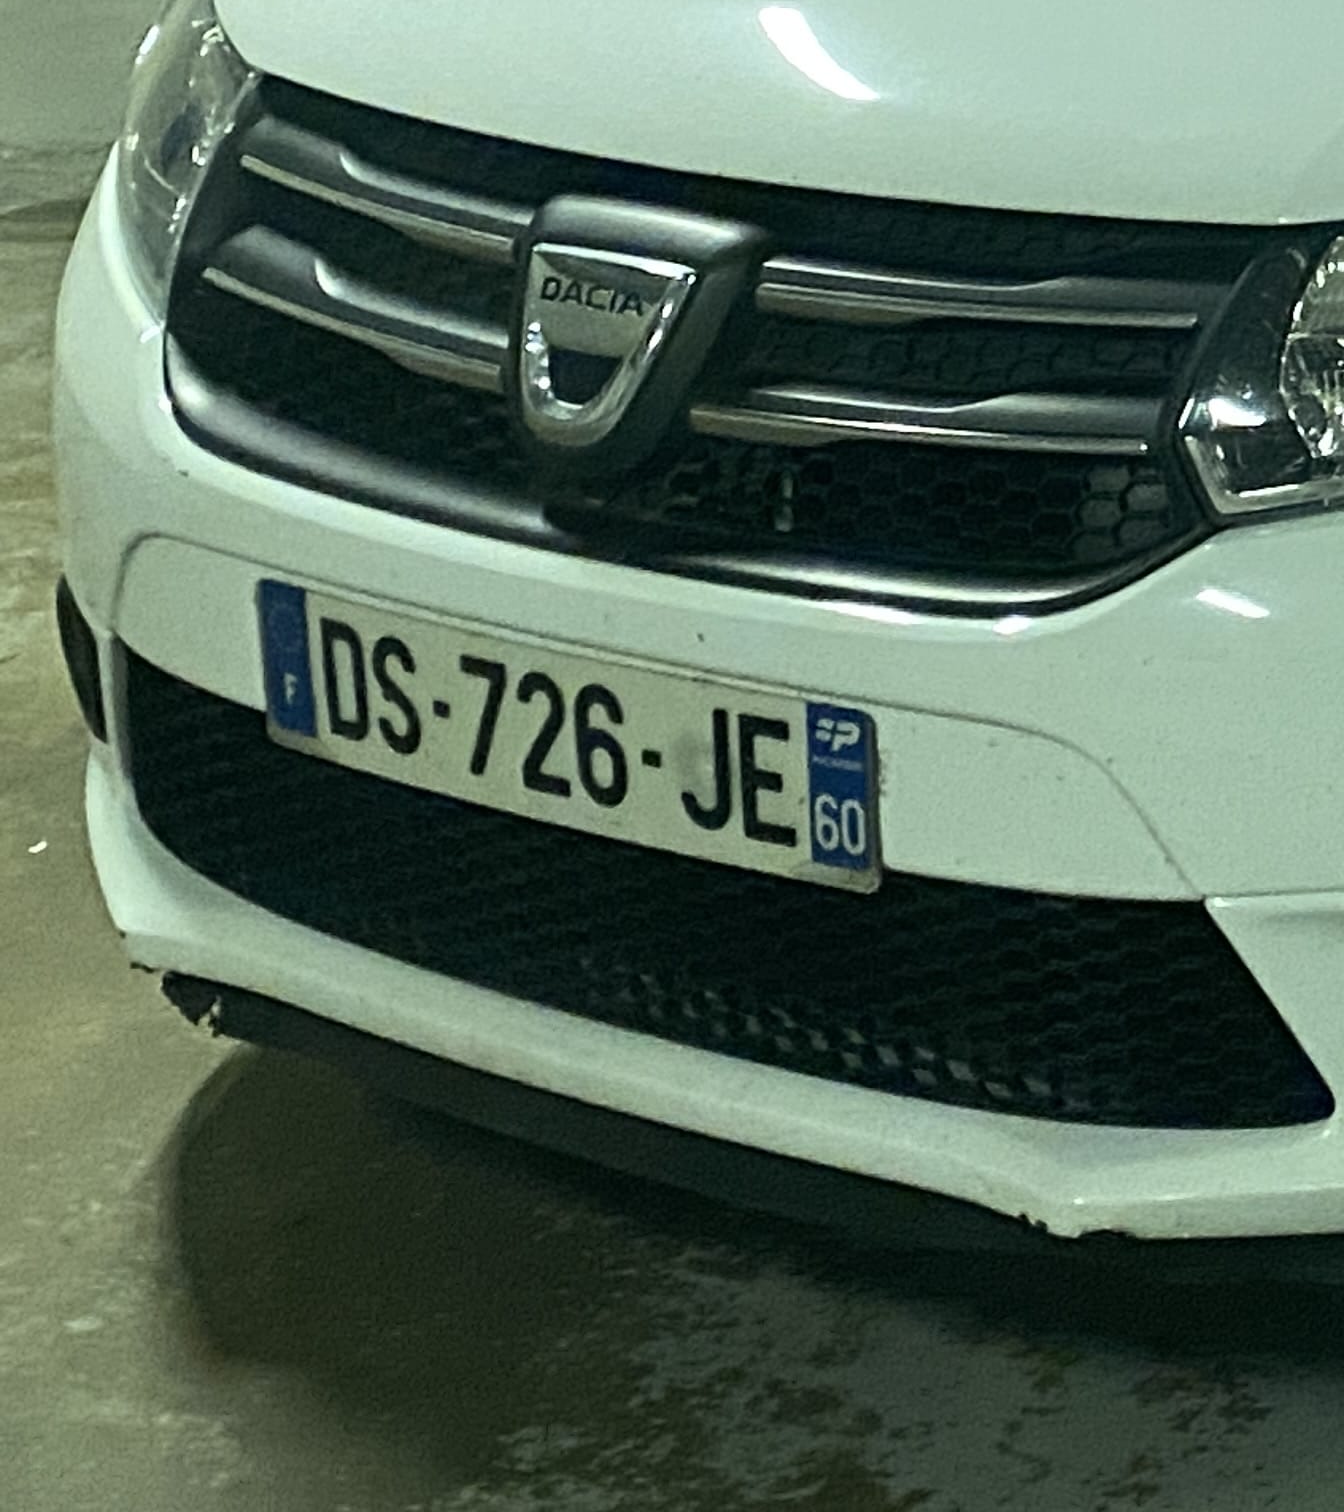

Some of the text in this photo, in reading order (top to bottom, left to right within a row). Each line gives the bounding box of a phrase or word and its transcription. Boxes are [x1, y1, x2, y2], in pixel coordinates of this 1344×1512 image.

[539, 276, 644, 316] DACIA
[284, 672, 298, 705] F
[815, 793, 866, 855] 60
